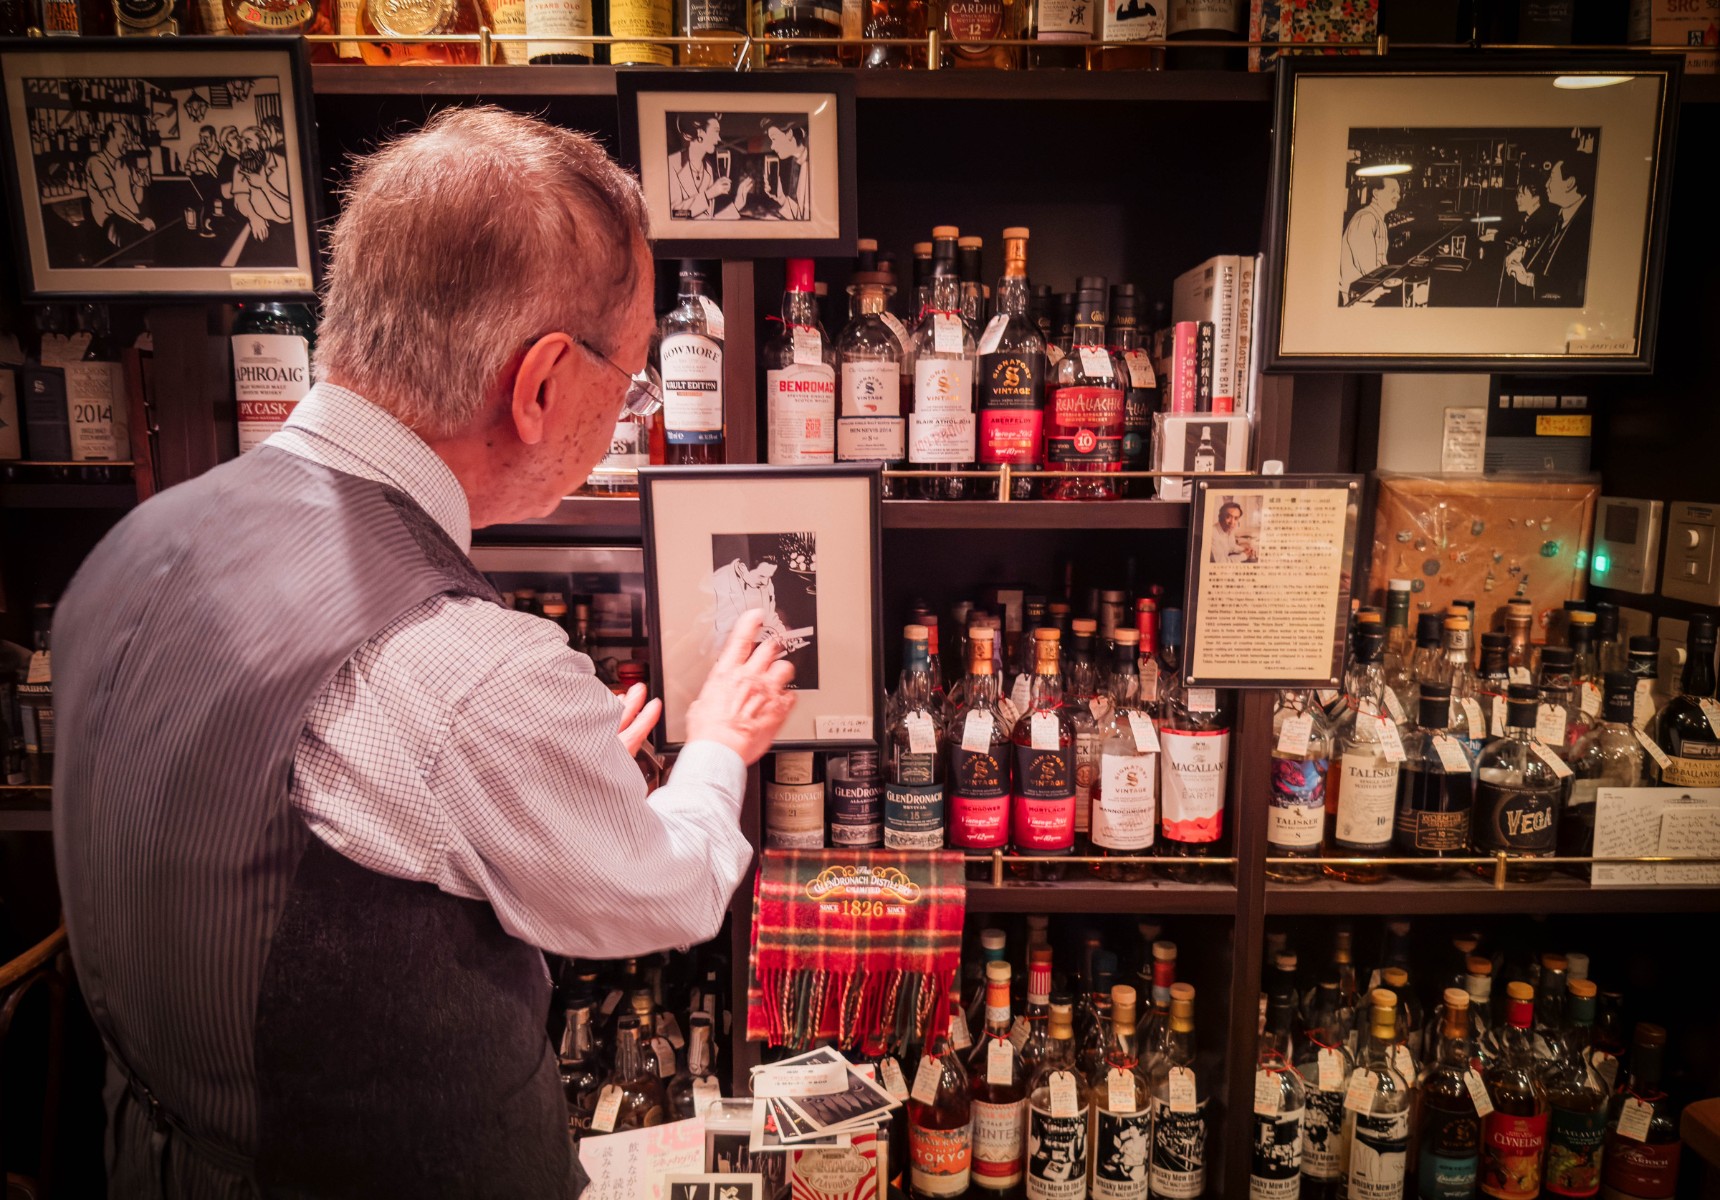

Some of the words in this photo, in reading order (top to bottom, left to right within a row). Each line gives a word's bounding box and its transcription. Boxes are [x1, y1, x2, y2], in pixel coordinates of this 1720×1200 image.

[951, 4, 1000, 14] CARDHU
[968, 24, 982, 35] 12
[1220, 344, 1227, 353] to
[663, 345, 720, 364] BOWMORE
[992, 358, 1032, 380] SIGNATORY
[666, 381, 687, 391] VAULT
[1219, 378, 1229, 394] BAR
[74, 404, 113, 424] 2014
[254, 402, 288, 416] CASK
[1078, 436, 1092, 446] 10
[1115, 764, 1148, 780] SIGNATORY
[1171, 762, 1224, 772] MACALLAN
[886, 791, 943, 804] GLENDRONACH
[1182, 792, 1216, 800] EARTH
[860, 804, 870, 813] 18
[1276, 817, 1318, 826] TALISKER
[1376, 816, 1386, 826] 10
[1506, 806, 1552, 836] VEGA
[856, 866, 872, 875] The
[814, 875, 869, 893] GLENDRONACH
[870, 876, 912, 894] DISTILLERY
[842, 900, 884, 916] 1826
[1494, 1132, 1542, 1148] CLYNELISH
[916, 1150, 965, 1163] TOKYO
[1172, 1172, 1186, 1181] Mew
[1047, 1180, 1060, 1191] Mew
[1061, 1181, 1070, 1190] to
[1118, 1180, 1132, 1191] Mew
[1133, 1180, 1139, 1190] to
[1268, 1180, 1283, 1189] Mew
[1352, 1177, 1374, 1191] Whisky
[1376, 1181, 1390, 1191] Mew
